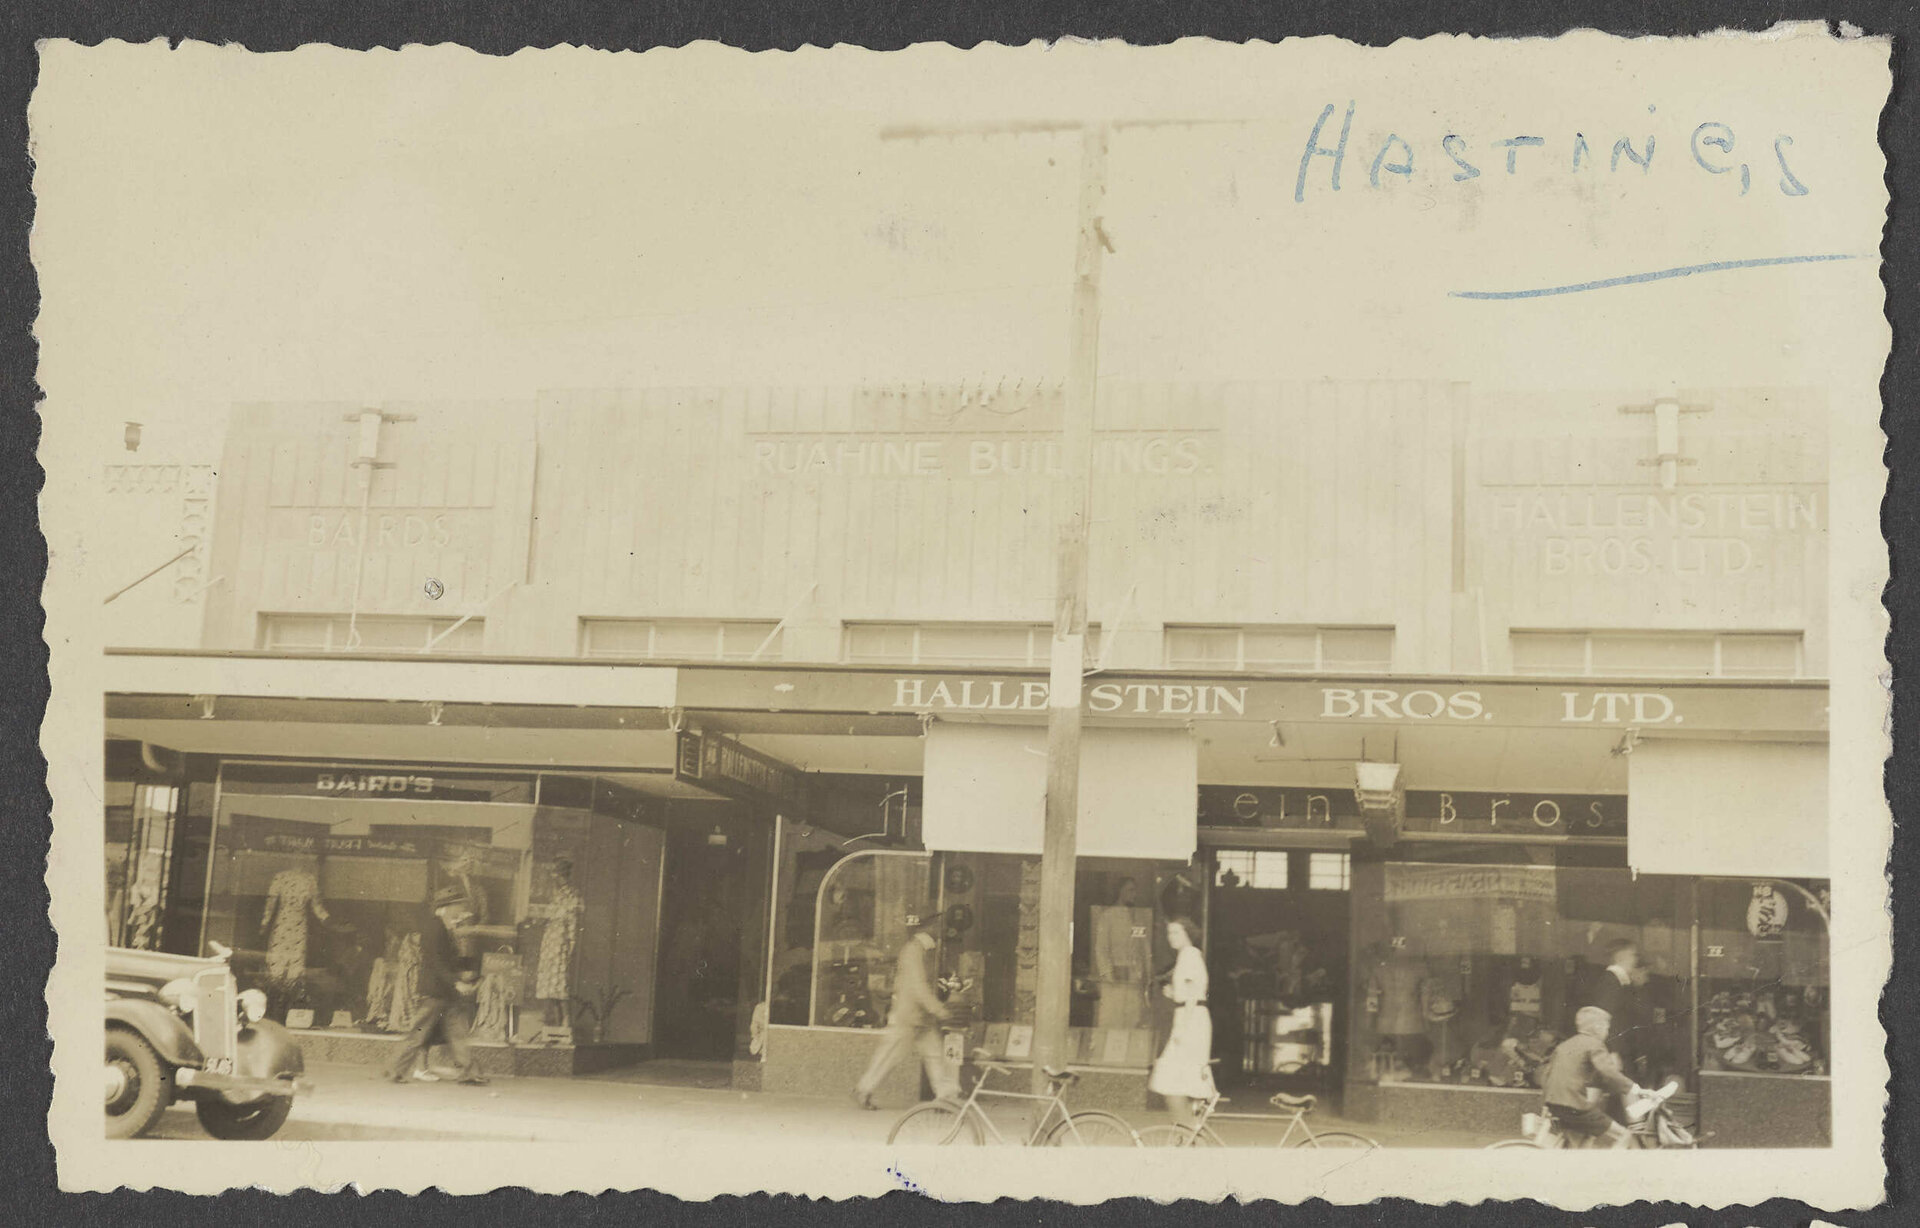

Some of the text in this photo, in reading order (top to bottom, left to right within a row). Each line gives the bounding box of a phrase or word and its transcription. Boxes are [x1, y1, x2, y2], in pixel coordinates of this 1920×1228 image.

[1295, 99, 1809, 202] HASTINGS
[754, 438, 1216, 476] RUAHINE BUILINGS.
[1493, 492, 1818, 530] HALLENSTEIN
[892, 678, 1684, 724] HALLESTEIN BROS. LTD.
[316, 774, 435, 793] BAIRD'S
[1440, 793, 1604, 828] Bros
